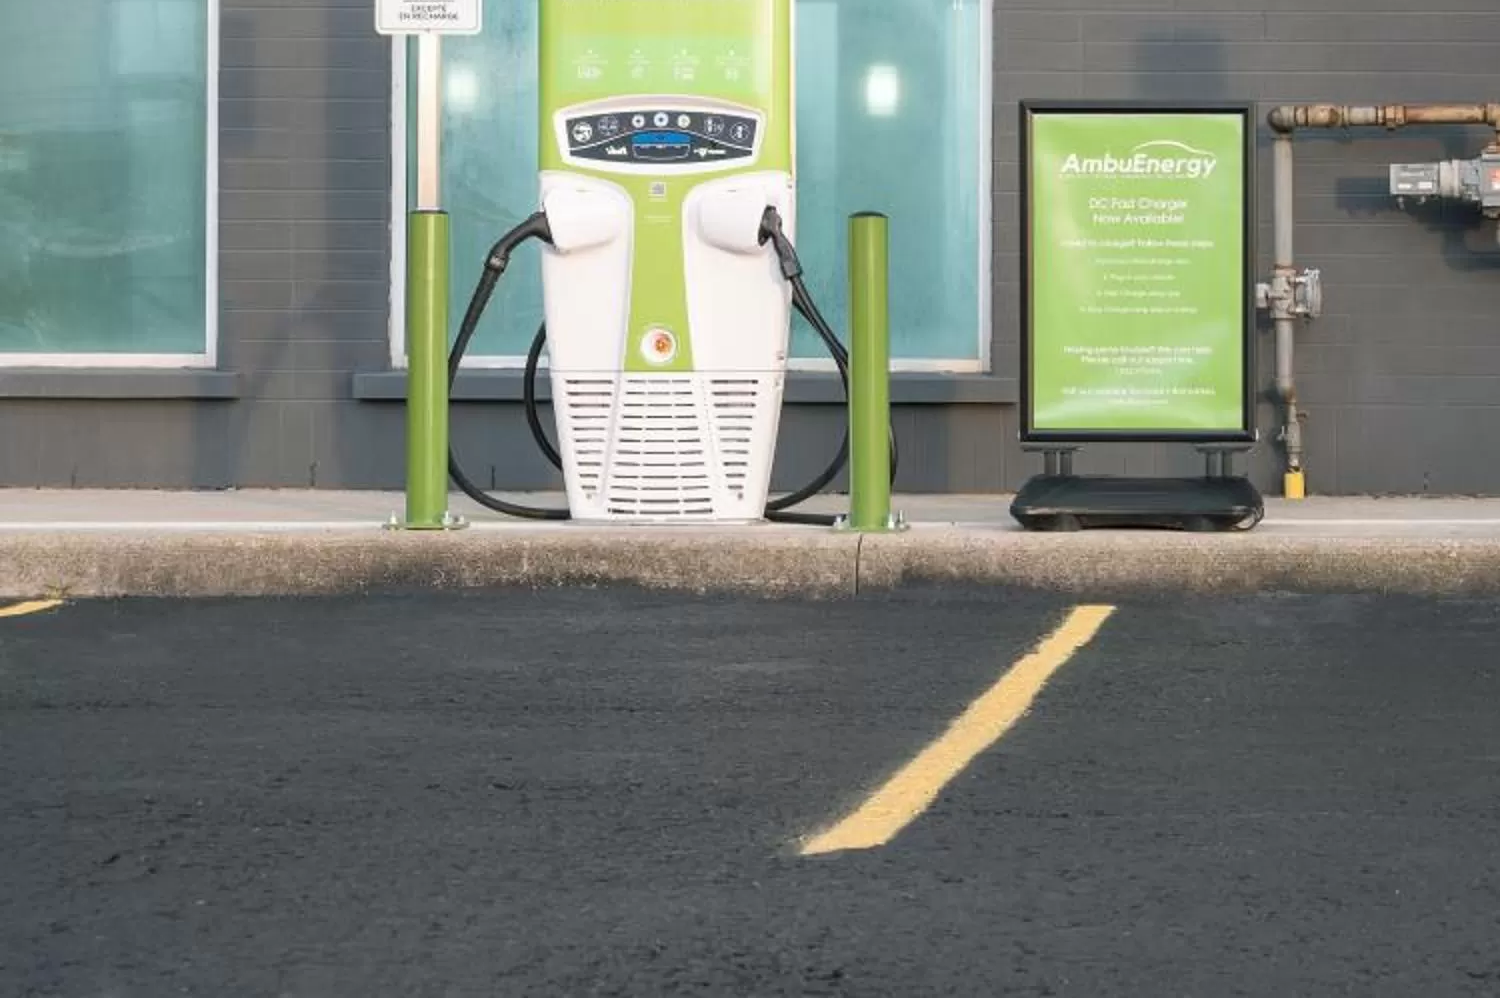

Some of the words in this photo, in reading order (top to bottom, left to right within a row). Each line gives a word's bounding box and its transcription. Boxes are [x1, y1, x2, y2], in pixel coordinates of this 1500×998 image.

[1062, 153, 1217, 178] AmbuEnergy
[1088, 197, 1107, 209] DC
[1111, 196, 1136, 209] Fast
[1137, 196, 1188, 211] Charger
[1092, 213, 1121, 224] Now
